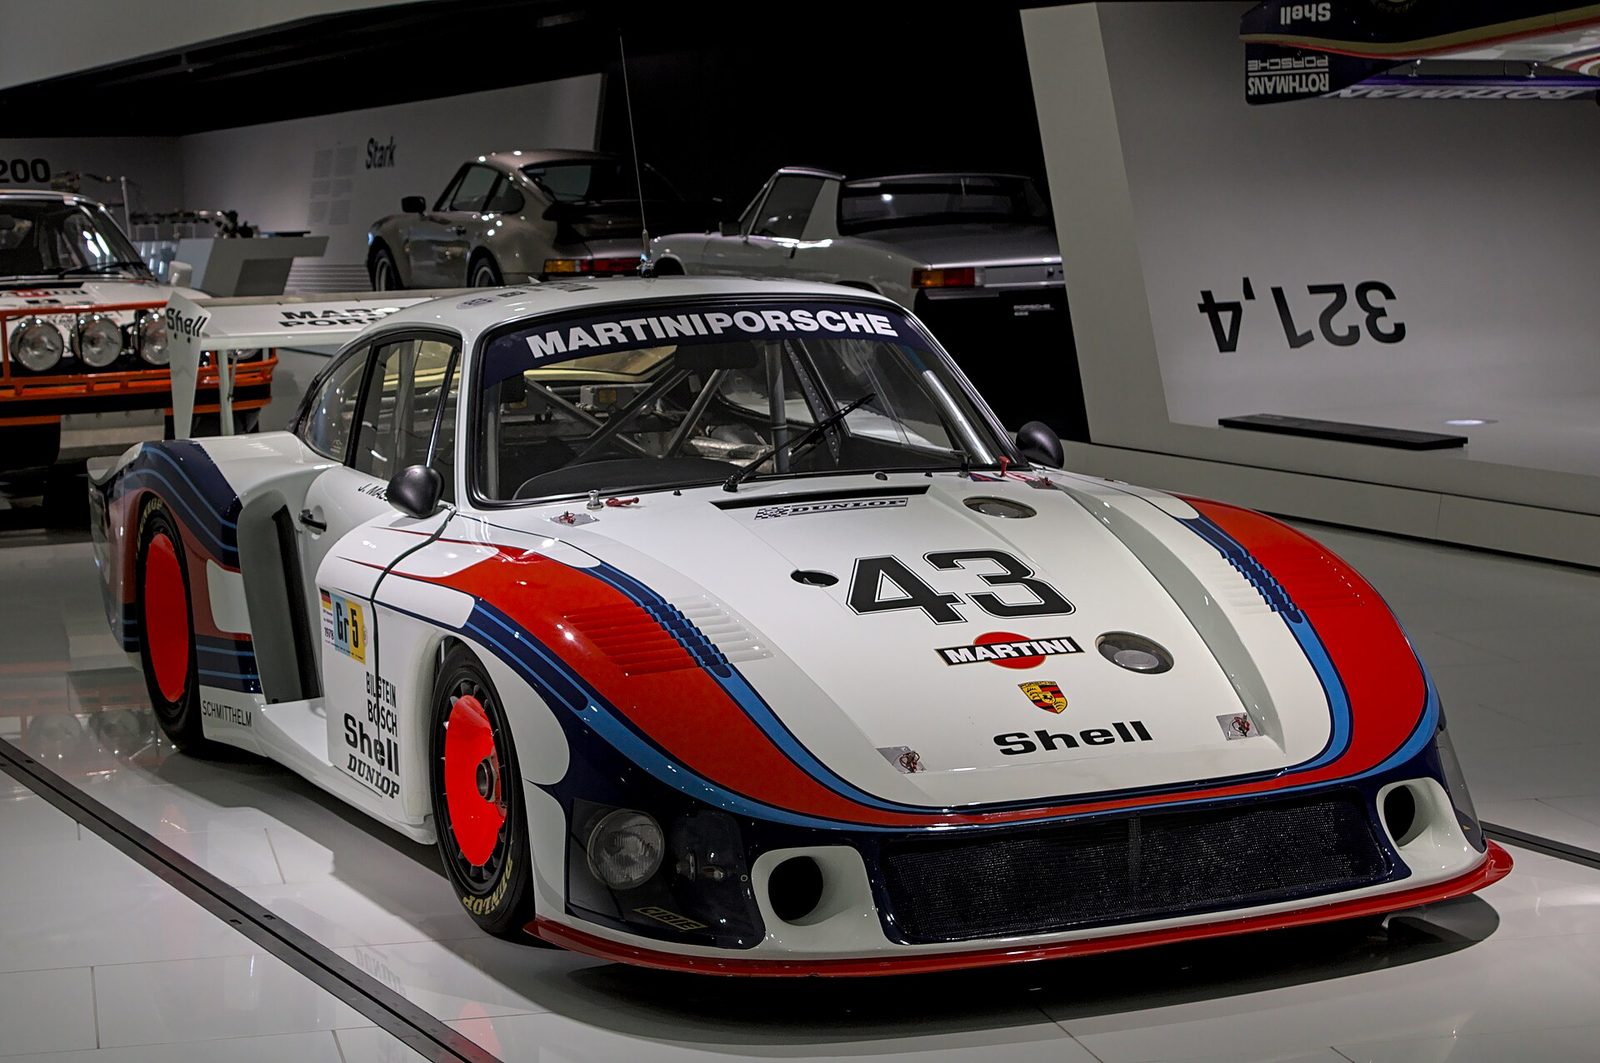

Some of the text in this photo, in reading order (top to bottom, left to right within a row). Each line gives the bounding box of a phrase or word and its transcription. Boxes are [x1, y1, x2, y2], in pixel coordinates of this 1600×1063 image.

[1279, 2, 1332, 25] Shell
[1247, 56, 1329, 71] PORSCHE
[1247, 72, 1330, 96] ROTHMANS
[365, 136, 397, 169] Stark
[166, 307, 208, 337] Shell
[1197, 277, 1406, 353] 321,4
[791, 500, 907, 514] DUNLOP
[846, 549, 1077, 626] 43
[336, 602, 360, 649] Gr 5
[943, 638, 1077, 665] MARTINI
[202, 700, 252, 728] SCHMITTHELM
[367, 699, 399, 737] BOSCH
[344, 712, 400, 777] Shell
[993, 720, 1153, 756] Shell
[347, 753, 400, 799] DUNLOP
